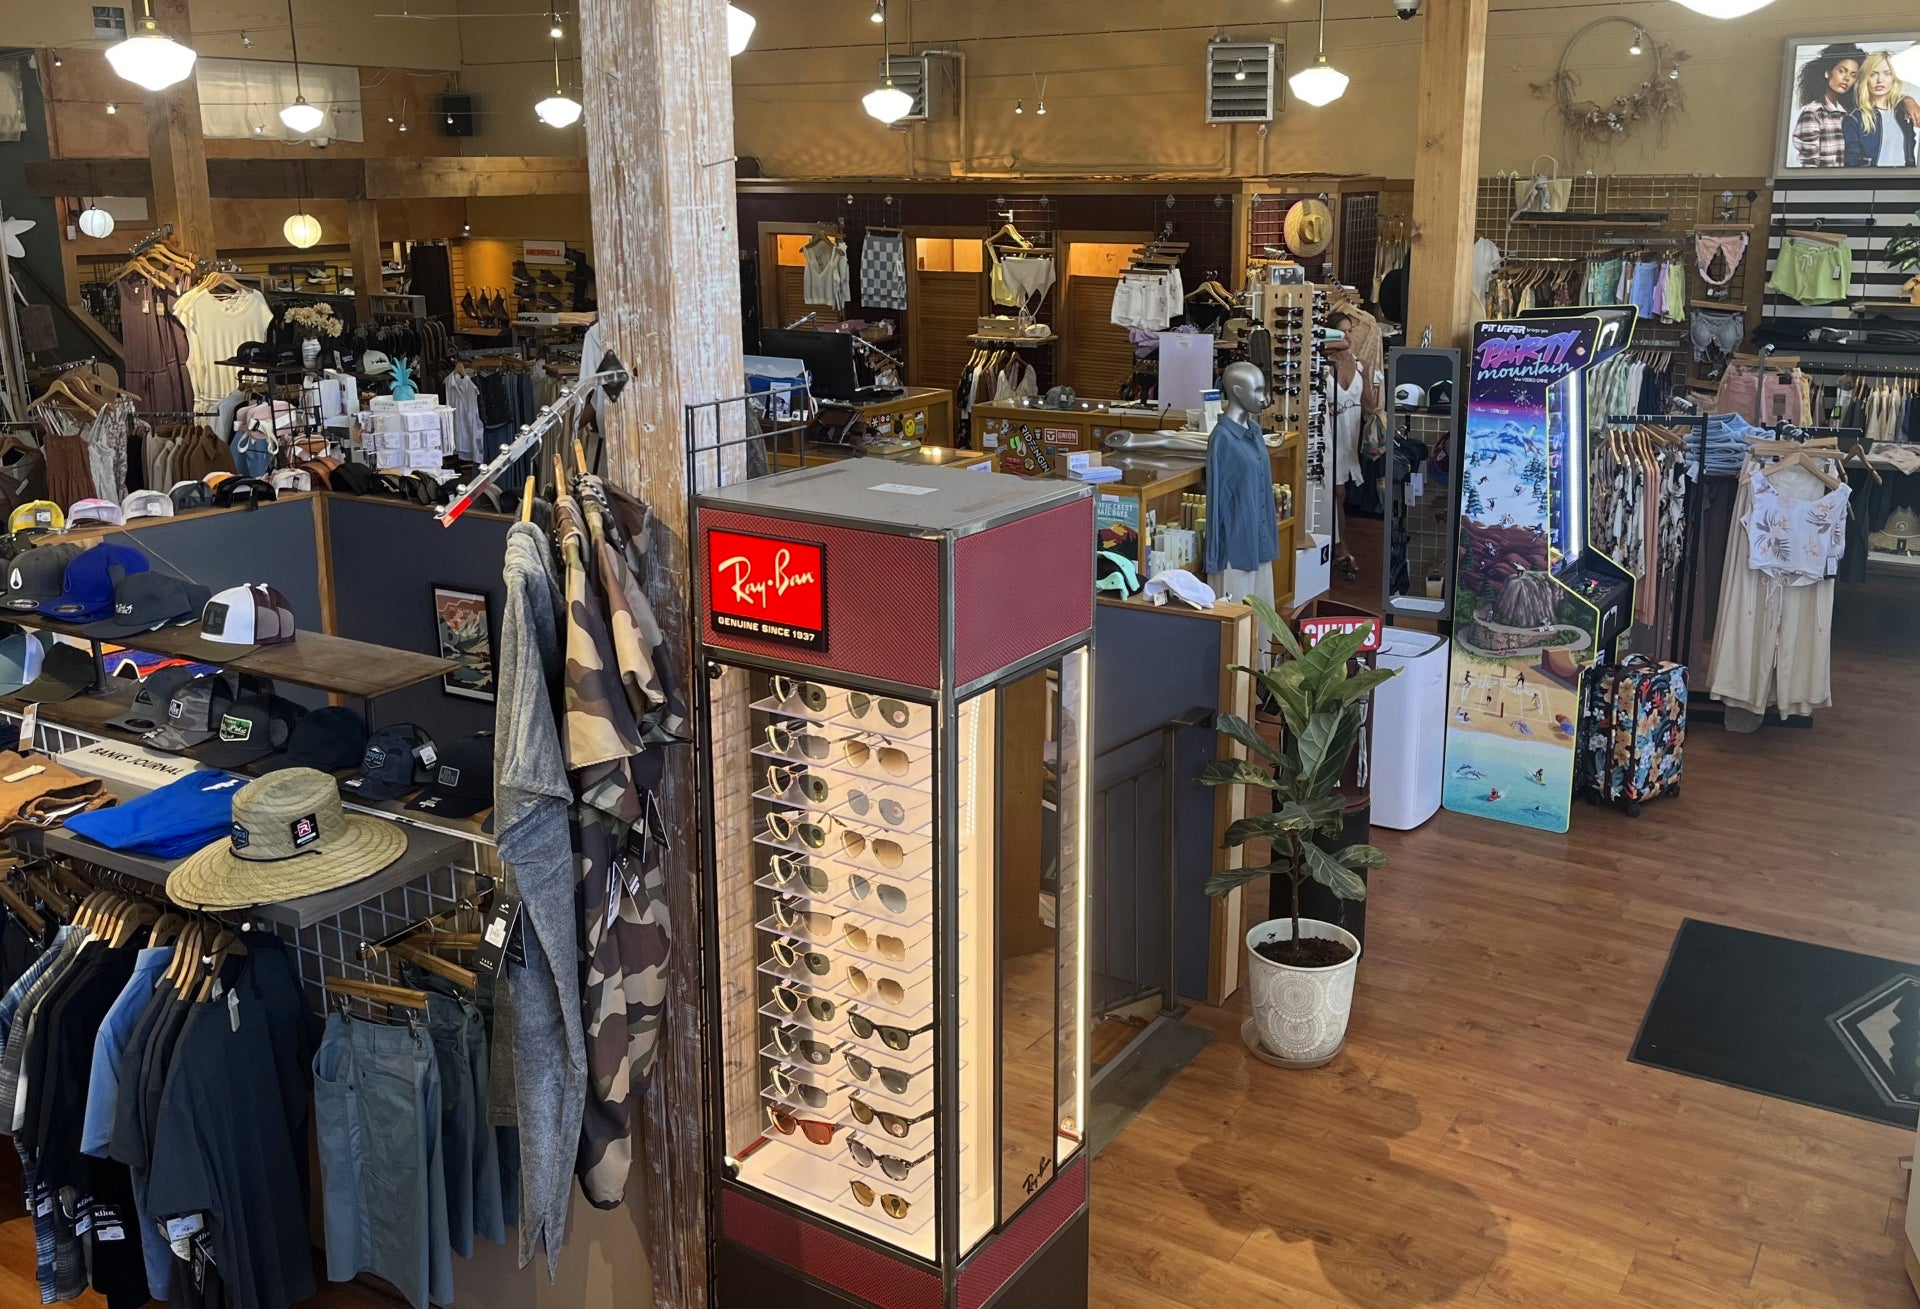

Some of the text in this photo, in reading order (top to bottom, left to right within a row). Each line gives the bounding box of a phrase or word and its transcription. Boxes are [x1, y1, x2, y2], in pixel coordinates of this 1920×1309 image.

[1476, 330, 1582, 369] PARTY
[1477, 353, 1573, 381] mountain
[1057, 432, 1076, 441] UNION
[718, 616, 815, 642] GENUINE SINCE 1937
[89, 747, 185, 776] BANKS JOURNAL
